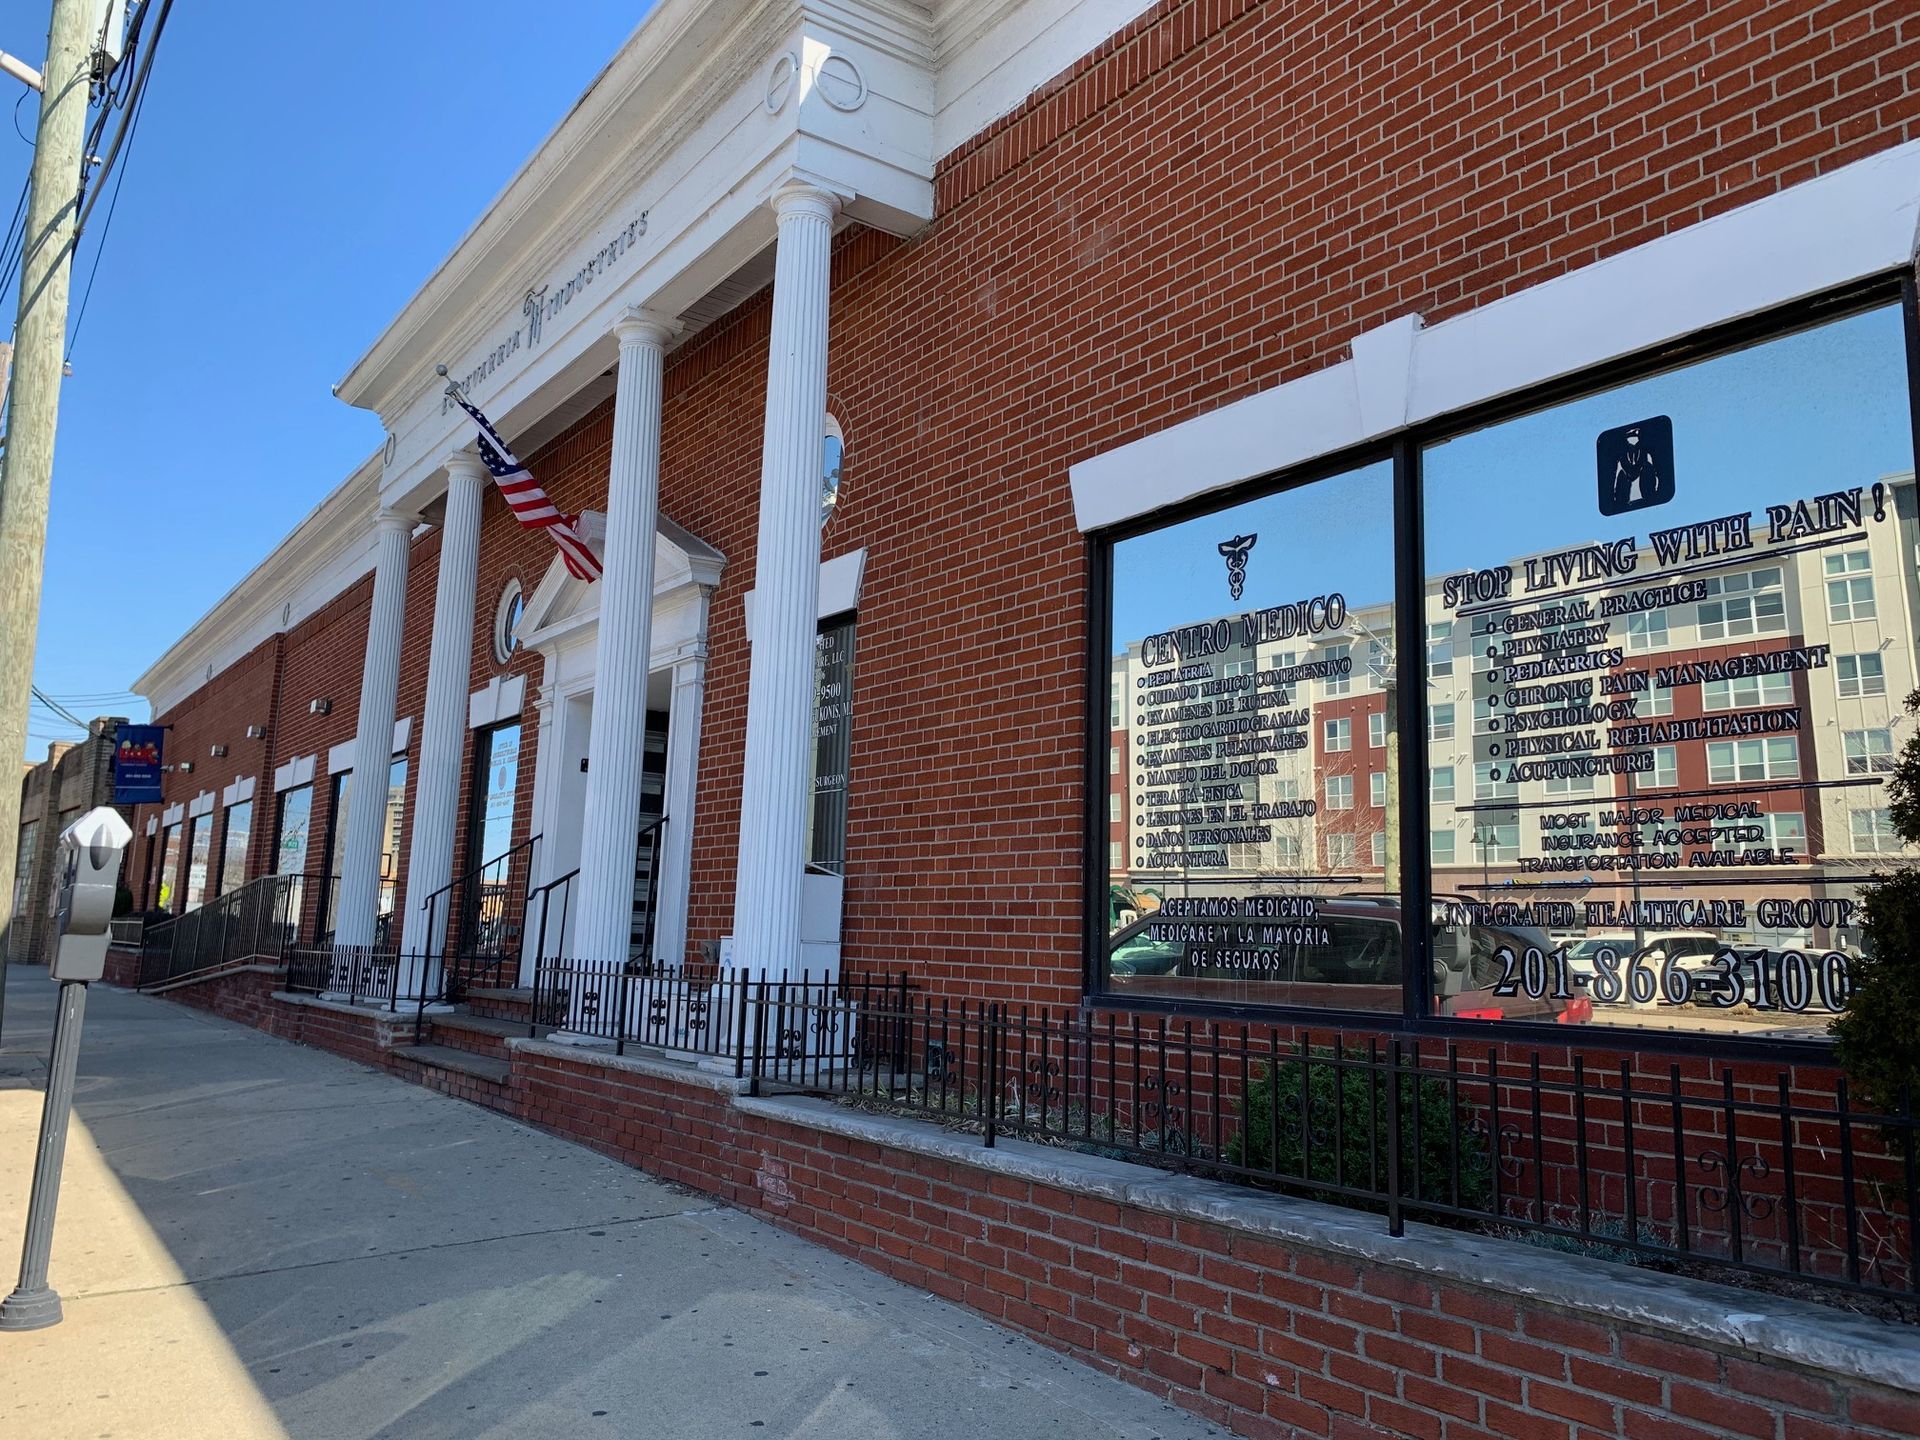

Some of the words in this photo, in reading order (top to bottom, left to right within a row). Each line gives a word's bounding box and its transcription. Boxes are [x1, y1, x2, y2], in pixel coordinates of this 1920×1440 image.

[547, 209, 649, 320] INDUSTRIES
[1442, 565, 1512, 609] STOP
[1524, 536, 1638, 592] LIVING
[1649, 511, 1753, 567] WITH
[1503, 601, 1594, 634] GENERAL
[1600, 579, 1708, 617] PRACTICE
[1141, 618, 1231, 668] CENTRO
[1241, 592, 1346, 648] MEDICO
[1502, 623, 1610, 659] PHYSIATRY
[832, 650, 845, 665] LLC
[1503, 647, 1623, 684] PEDIATRICS
[1147, 684, 1198, 706] CUIDADO
[1201, 675, 1250, 698] MEDICO
[1255, 657, 1352, 688] COMPRENSIVO
[1148, 661, 1214, 687] PEDIATRIA
[1503, 676, 1592, 707] CHRONIC
[1600, 671, 1649, 695] PAIN
[1656, 644, 1830, 688] MANAGEMENT
[1147, 702, 1212, 726] EXAMENES
[1216, 699, 1234, 715] DE
[1238, 689, 1289, 712] RUTINA
[1504, 698, 1638, 733] PSYCHOLOGY
[1147, 708, 1310, 746] ELECTROCARDIOGRAMAS
[1505, 729, 1601, 758] PHYSICAL
[1607, 708, 1801, 749] REHABILITATION
[1147, 743, 1212, 767] EXAMENES
[1216, 732, 1309, 759] PULMONARES
[815, 773, 845, 788] SURGEON
[1146, 766, 1197, 786] MANEJO
[1201, 763, 1226, 781] DEL
[1230, 758, 1278, 779] DOLOR
[1506, 750, 1655, 783] ACUPUNCTURE
[1146, 787, 1198, 807] TERAPIA
[1202, 783, 1243, 802] FISICA
[1146, 807, 1203, 827] LESIONES
[1207, 805, 1225, 822] EN
[1230, 804, 1247, 821] EL
[1252, 799, 1316, 821] TRABAJO
[1540, 812, 1590, 830] MOST
[1599, 808, 1664, 827] MAJOR
[1674, 802, 1765, 823] MEDICAL
[1146, 827, 1184, 848] DAÑOS
[1189, 825, 1271, 846] PERSONALES
[1541, 831, 1644, 851] INSURANCE
[1653, 825, 1765, 846] ACCEPTED.
[1145, 850, 1228, 868] ACUPUNTURA
[1517, 851, 1679, 873] TRANSPORTATION
[1689, 847, 1800, 867] AVAILABLE.
[1158, 898, 1237, 919] ACEPTAMOS
[1244, 897, 1320, 921] MEDICAID,
[1447, 900, 1576, 928] INTEGRATED
[1585, 899, 1747, 928] HEALTHCARE
[1756, 898, 1854, 928] GROUP
[1149, 923, 1214, 943] MEDICARE
[1220, 925, 1229, 943] Y
[1237, 924, 1255, 944] LA
[1262, 924, 1331, 946] MAYORIA
[1191, 950, 1208, 968] DE
[1215, 950, 1281, 971] SEGUROS
[1493, 945, 1852, 1014] 201-866-3100
